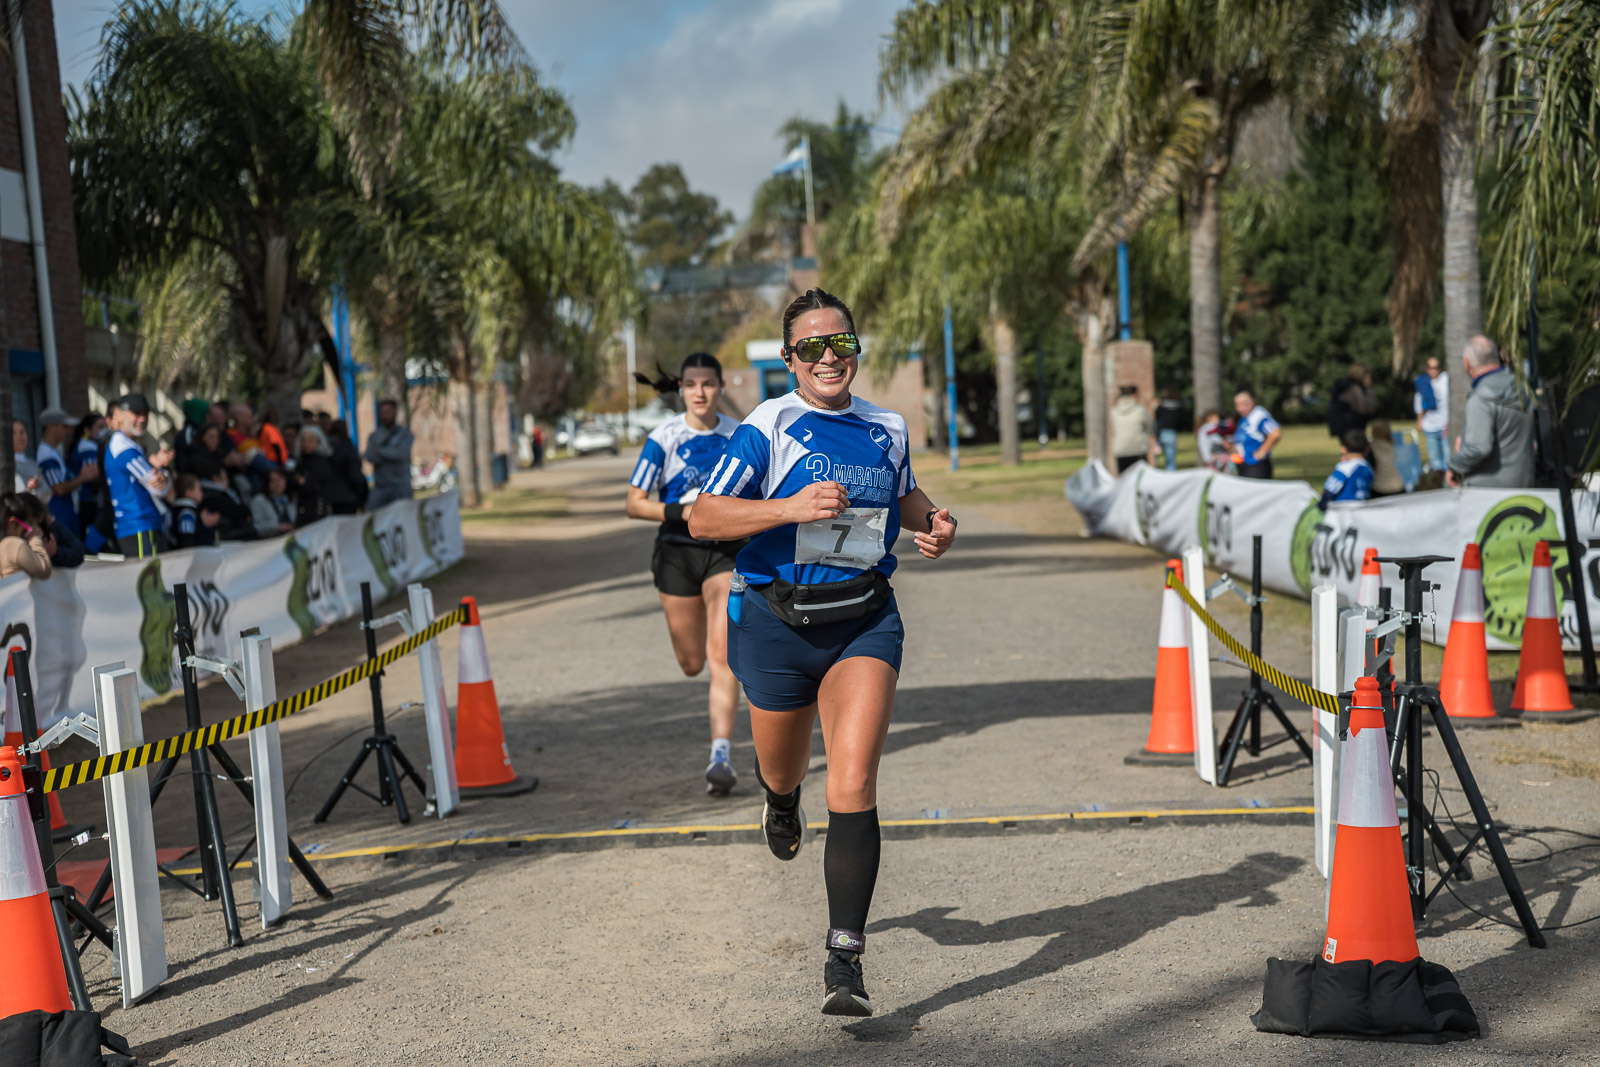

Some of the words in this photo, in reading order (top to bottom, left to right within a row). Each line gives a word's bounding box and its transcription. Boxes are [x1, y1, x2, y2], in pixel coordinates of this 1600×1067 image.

[806, 453, 830, 482] 3
[833, 464, 894, 491] MARATÓN
[831, 524, 851, 553] 7
